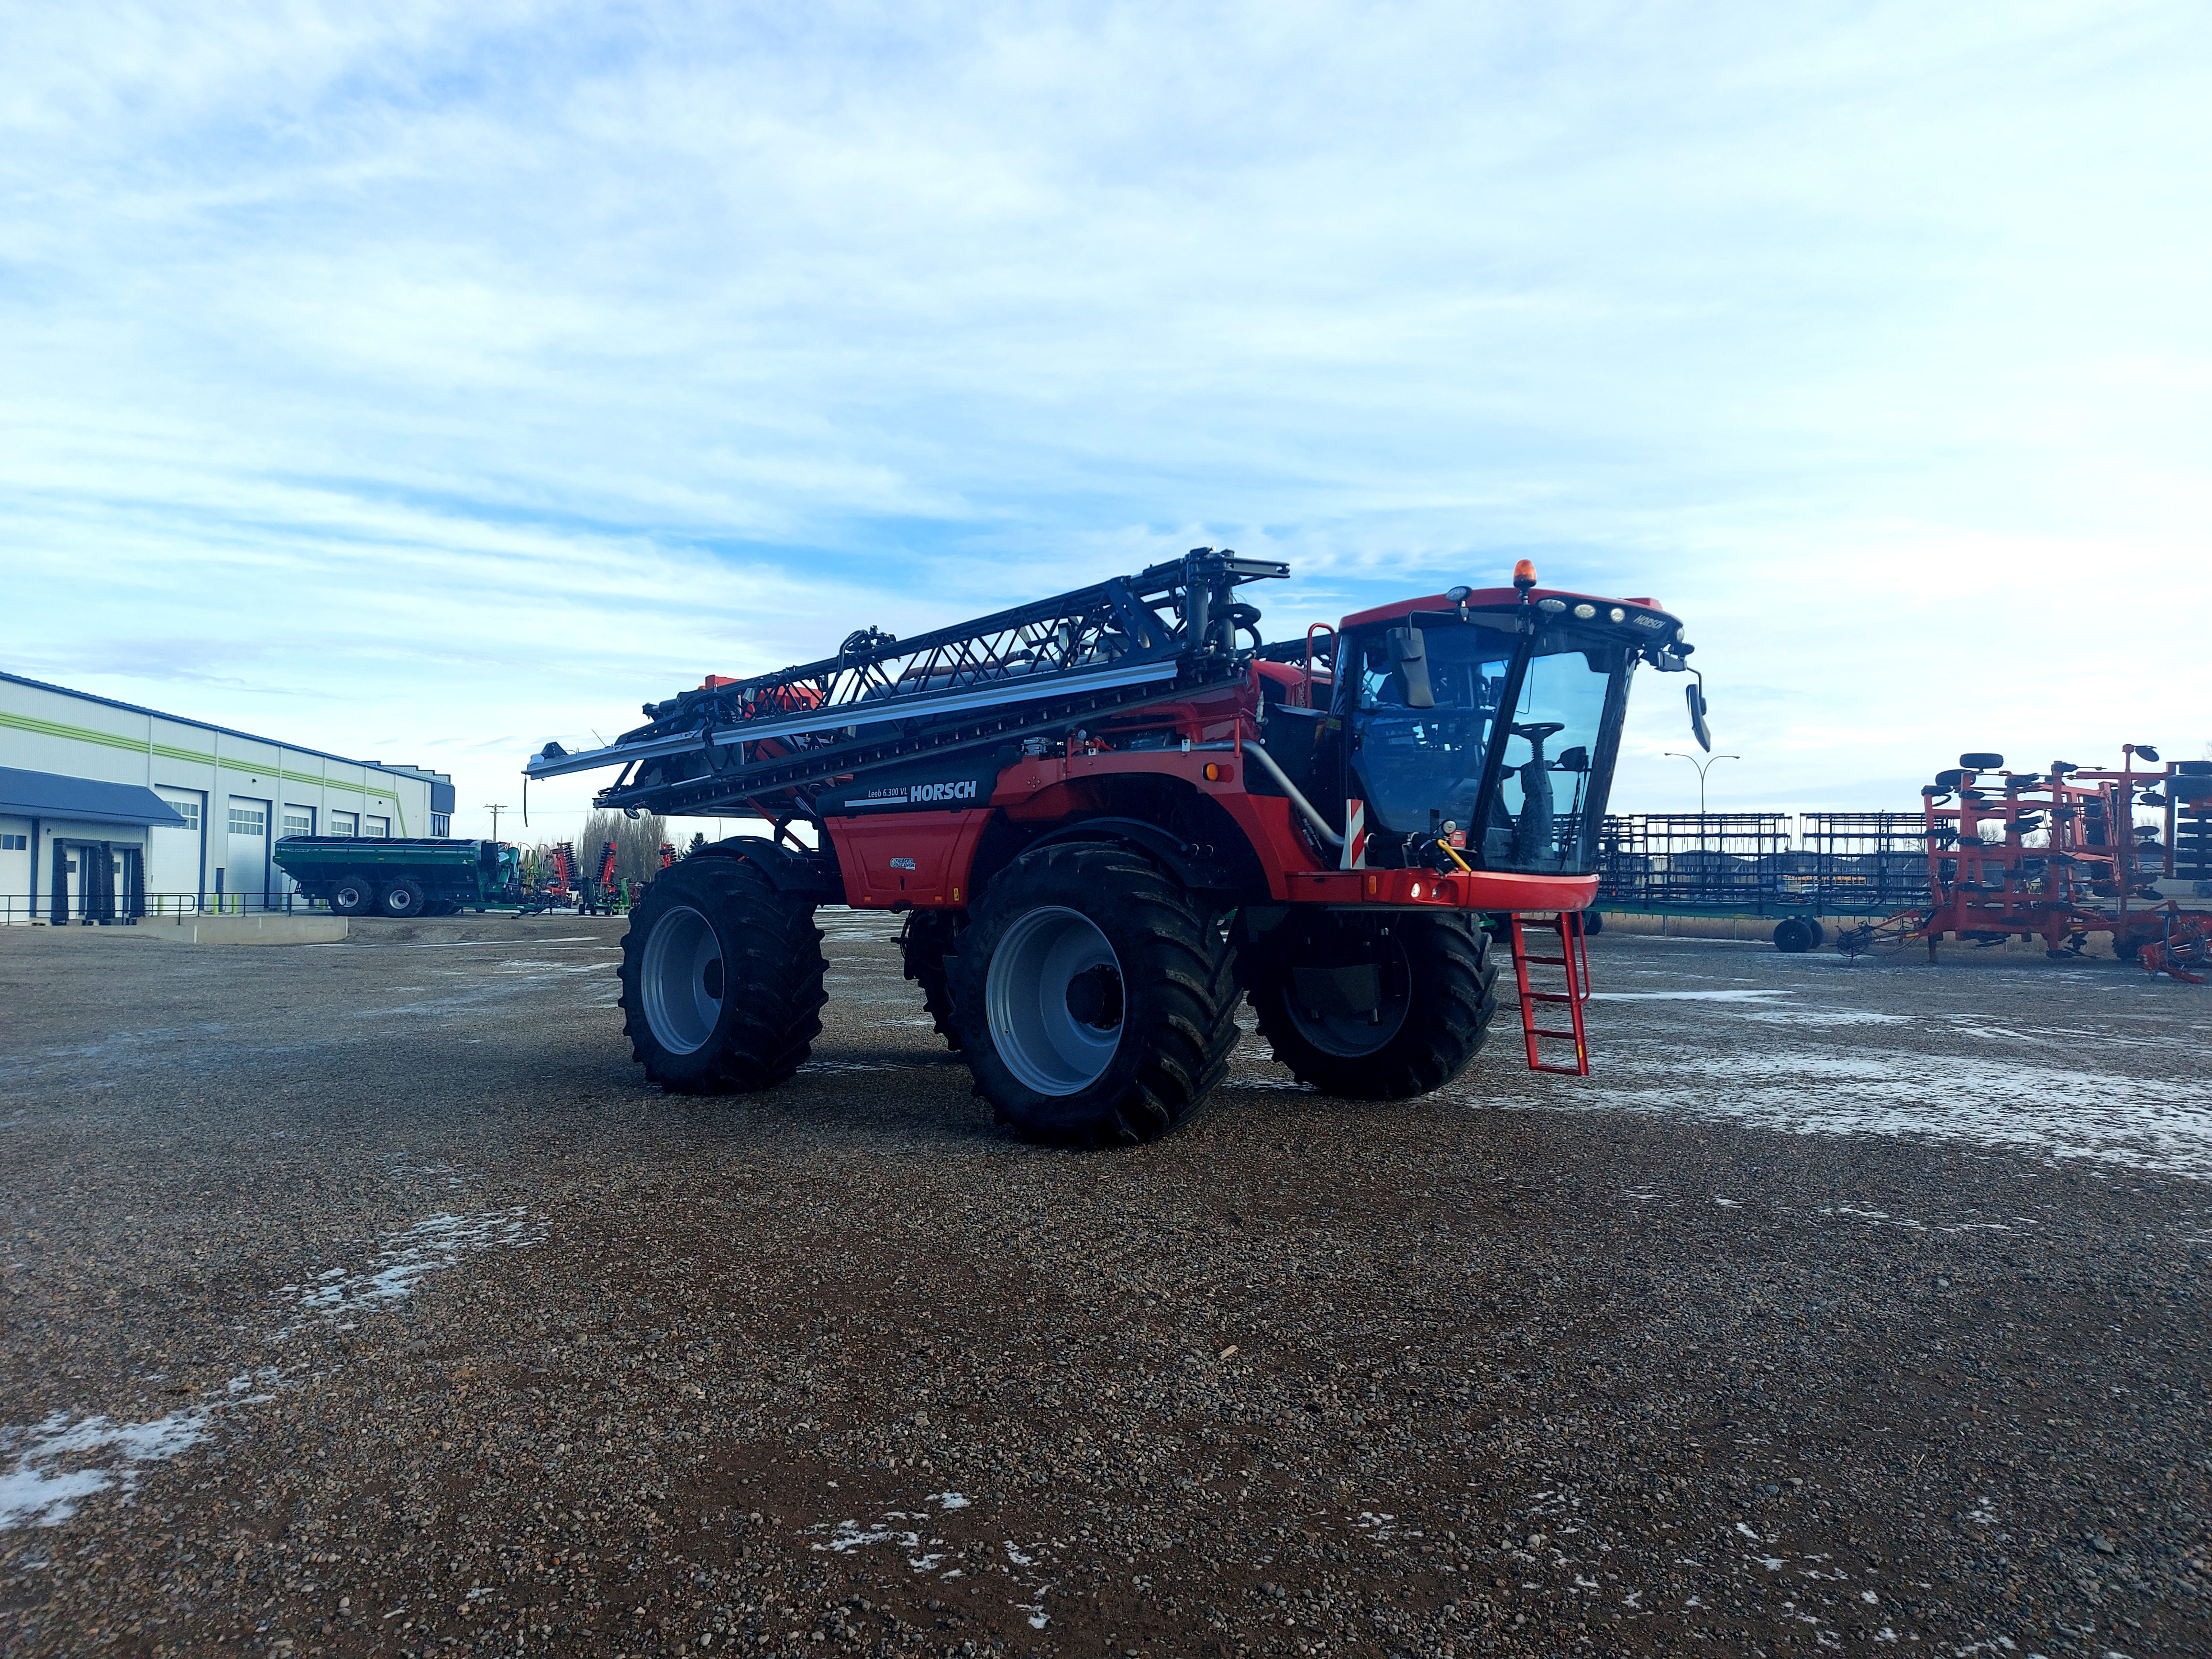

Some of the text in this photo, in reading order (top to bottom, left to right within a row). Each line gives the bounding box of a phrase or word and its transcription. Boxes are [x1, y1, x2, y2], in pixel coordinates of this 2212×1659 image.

[1633, 615, 1666, 629] HORSCH
[868, 787, 907, 797] Leeb 6.300 VL
[910, 781, 977, 802] HORSCH
